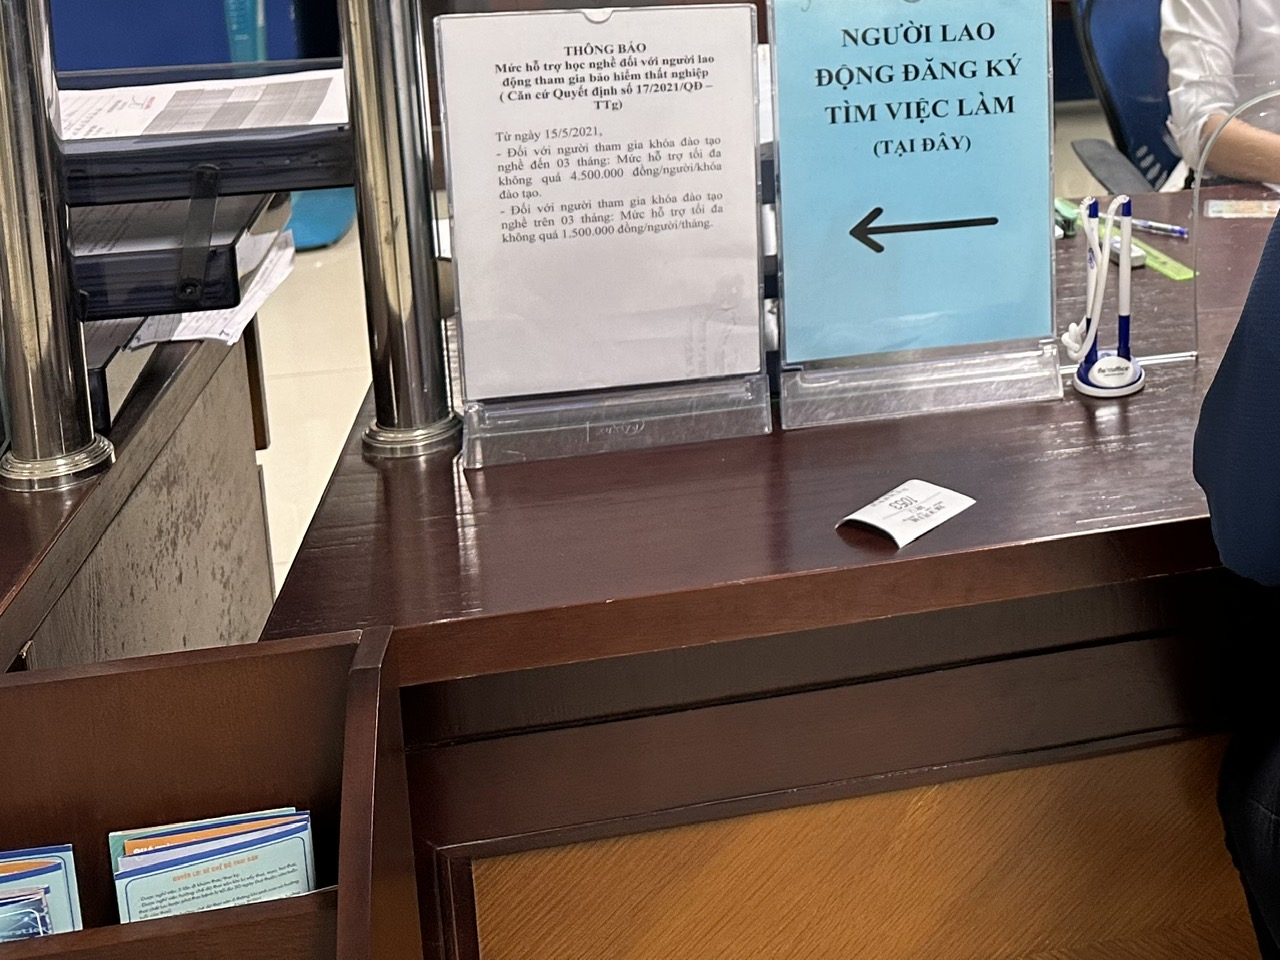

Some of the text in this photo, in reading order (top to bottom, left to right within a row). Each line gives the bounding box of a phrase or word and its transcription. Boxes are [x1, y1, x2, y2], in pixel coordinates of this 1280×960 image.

[841, 20, 995, 47] NGƯỜI LAO
[564, 41, 646, 56] THÔNG BÁO
[495, 55, 714, 73] Mức hỗ trợ học nghề đối với người lao
[815, 53, 1022, 90] ĐỘNG ĐĂNG KÝ
[503, 68, 708, 88] động tham gia bảo hiểm thất nghiệp
[536, 90, 550, 99] cứ
[553, 85, 587, 100] Quyết
[592, 87, 617, 98] định
[621, 82, 632, 95] số
[594, 100, 622, 110] TTg)
[825, 91, 1016, 125] TÌM VIỆC LÀM
[496, 132, 512, 142] Từ
[515, 130, 540, 143] ngày
[873, 132, 972, 158] (TẠI ĐÂY)
[508, 145, 527, 157] Đối
[534, 146, 551, 155] với
[558, 143, 588, 155] người
[595, 143, 621, 152] tham
[628, 140, 643, 152] gia
[650, 138, 675, 149] khóa
[681, 137, 700, 146] đào
[705, 137, 721, 145] tạo
[498, 147, 721, 173] nghề đến 03 tháng: Mức hỗ trợ tối đa
[499, 177, 532, 186] không
[542, 172, 561, 185] quá
[571, 168, 623, 180] 4.500.000
[499, 189, 541, 199] đào tạo.
[511, 203, 530, 215] Đối
[537, 204, 554, 213] với
[561, 200, 591, 213] người
[598, 200, 624, 208] tham
[630, 196, 646, 208] gia
[652, 194, 677, 205] khóa
[683, 192, 701, 202] đào
[707, 192, 723, 201] tạo
[502, 203, 723, 231] nghề trên 03 tháng: Mức hỗ trợ tối đa
[502, 233, 536, 243] không
[539, 230, 558, 242] quá
[563, 225, 614, 238] 1.500.000
